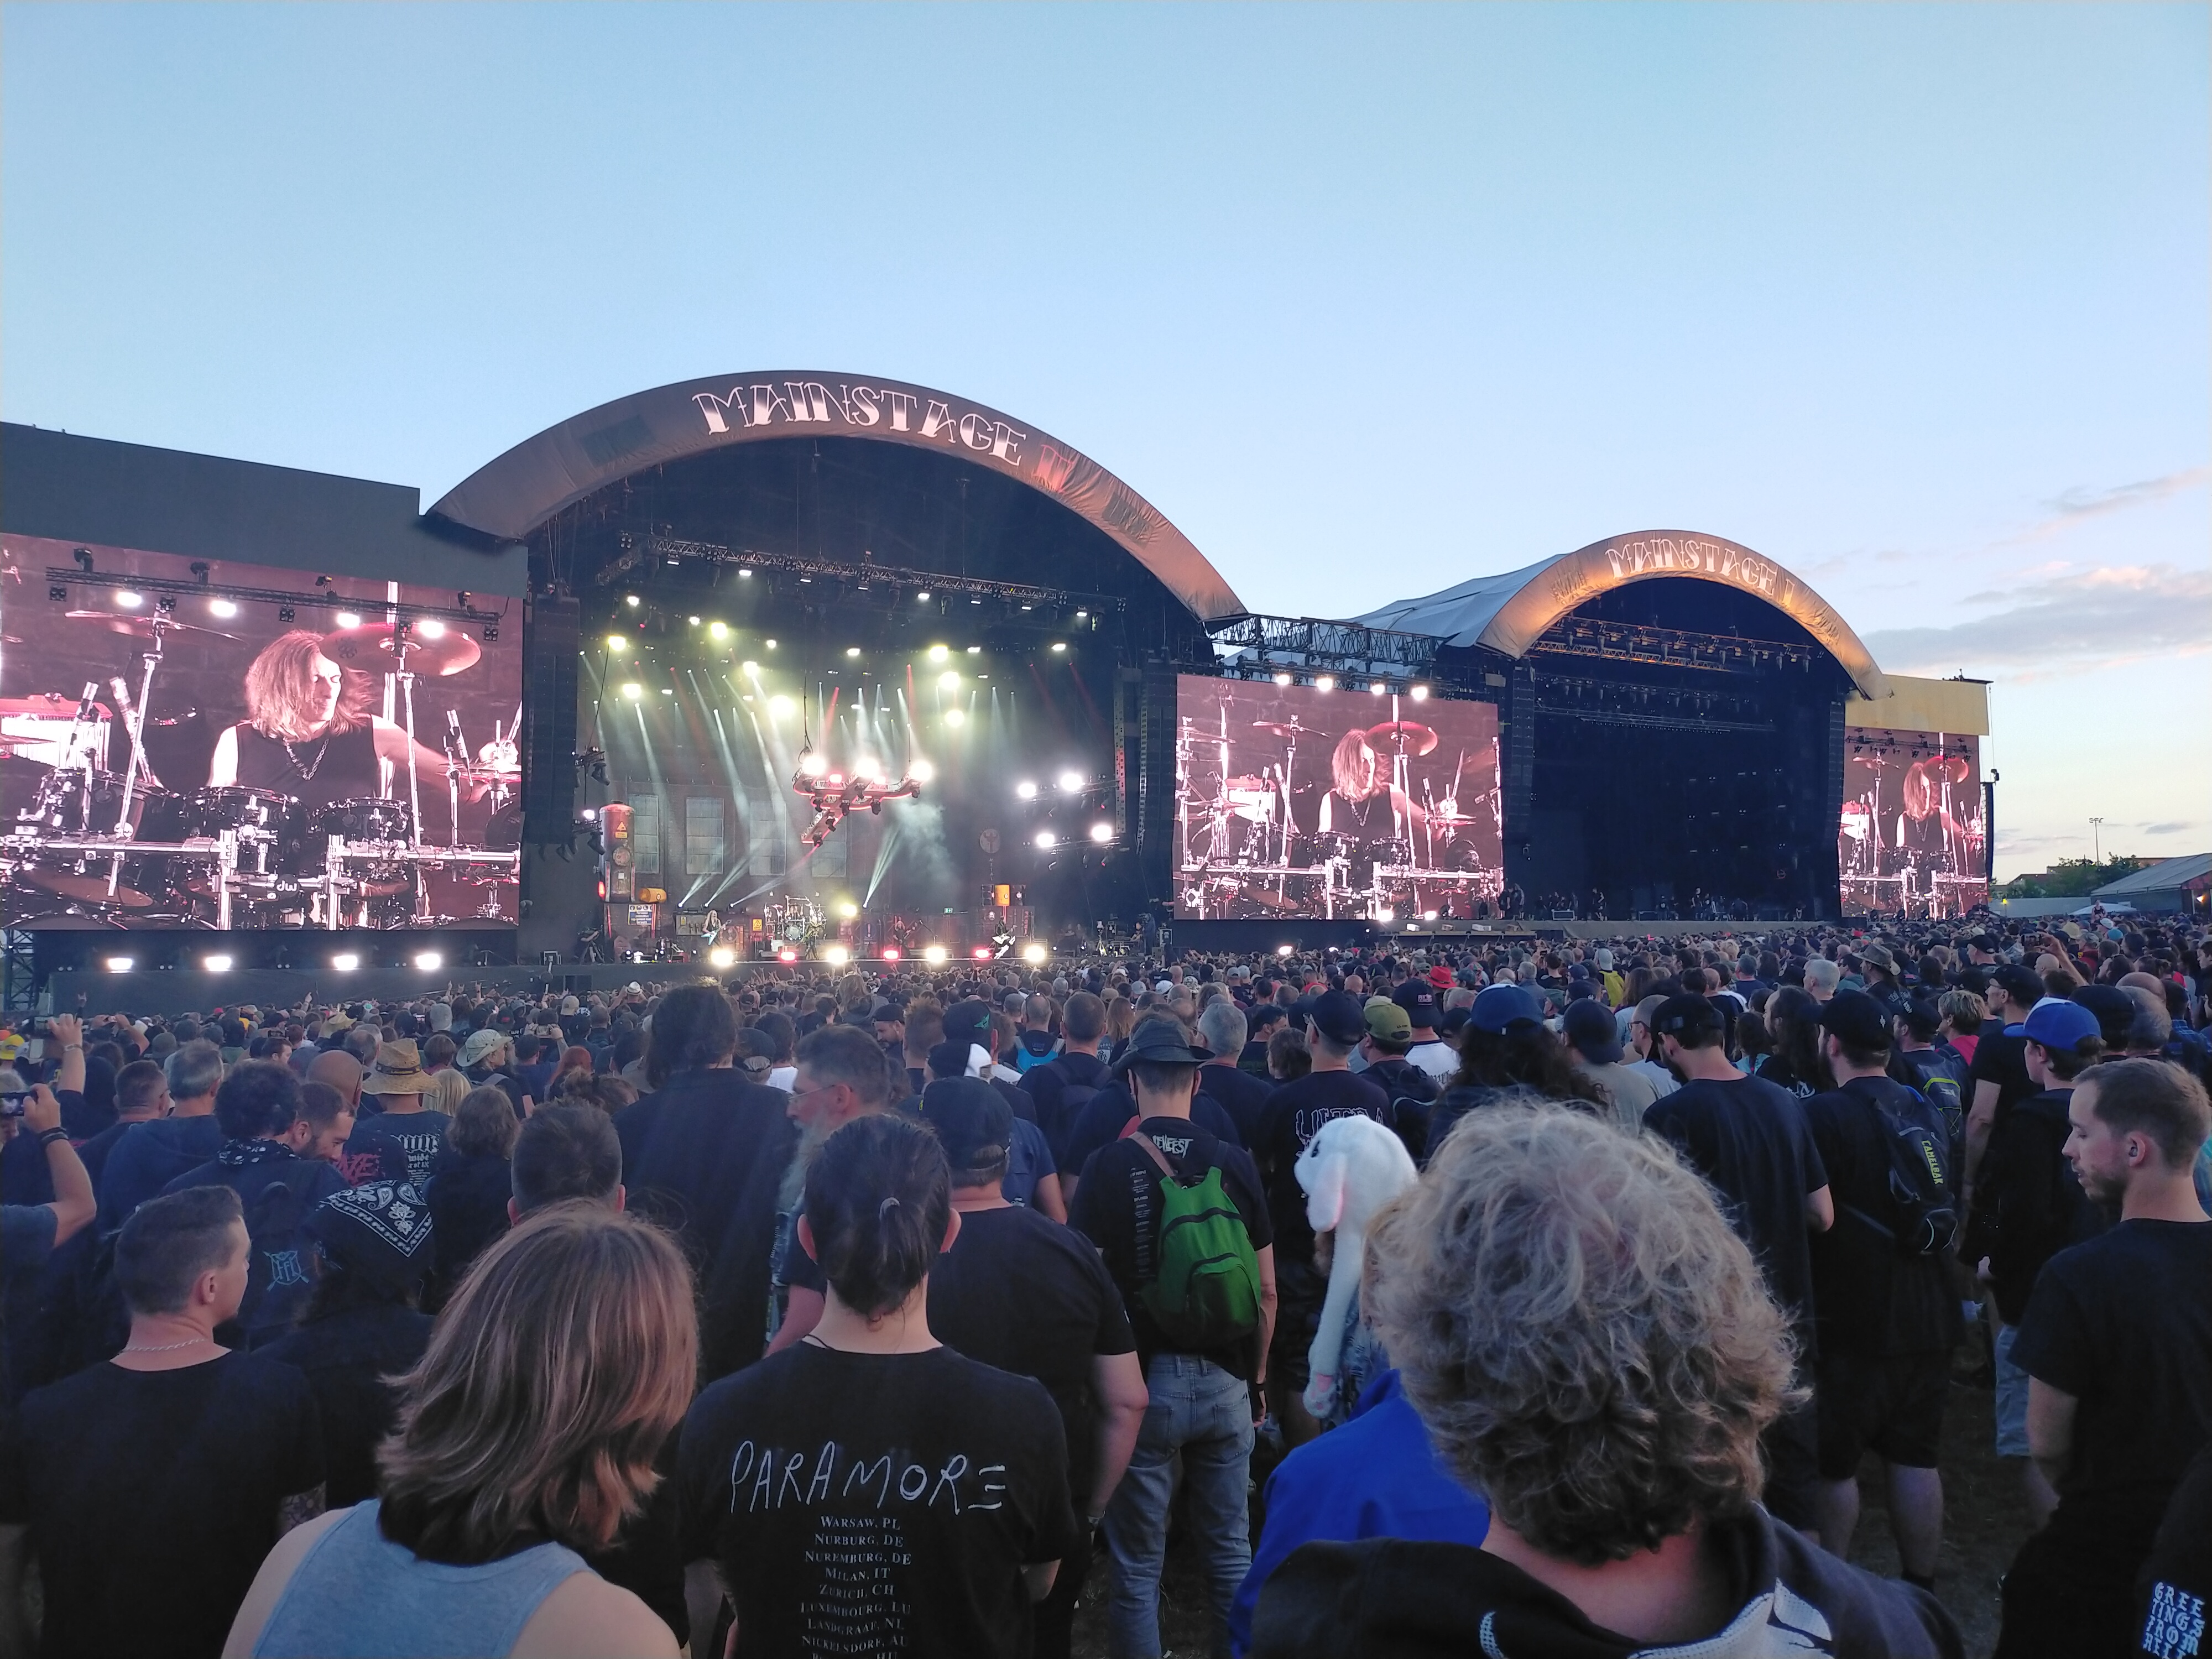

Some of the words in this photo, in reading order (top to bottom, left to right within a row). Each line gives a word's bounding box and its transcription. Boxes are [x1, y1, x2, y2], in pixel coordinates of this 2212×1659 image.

[692, 382, 1026, 466] MAINSTAGE
[1605, 539, 1777, 596] MAINSTAGE
[1921, 1140, 1944, 1185] CAMELBAK
[731, 1440, 1005, 1515] PARAMORE
[821, 1515, 878, 1528] WARSAW,
[883, 1517, 901, 1530] PL
[883, 1534, 904, 1547] DE
[892, 1552, 911, 1565] DE
[825, 1567, 870, 1582] MILAN,
[874, 1567, 890, 1579] IT
[872, 1584, 894, 1596] CH
[892, 1601, 911, 1614] LU
[885, 1618, 905, 1630] NL
[890, 1635, 908, 1646] AU
[2146, 1614, 2198, 1656] FROM
